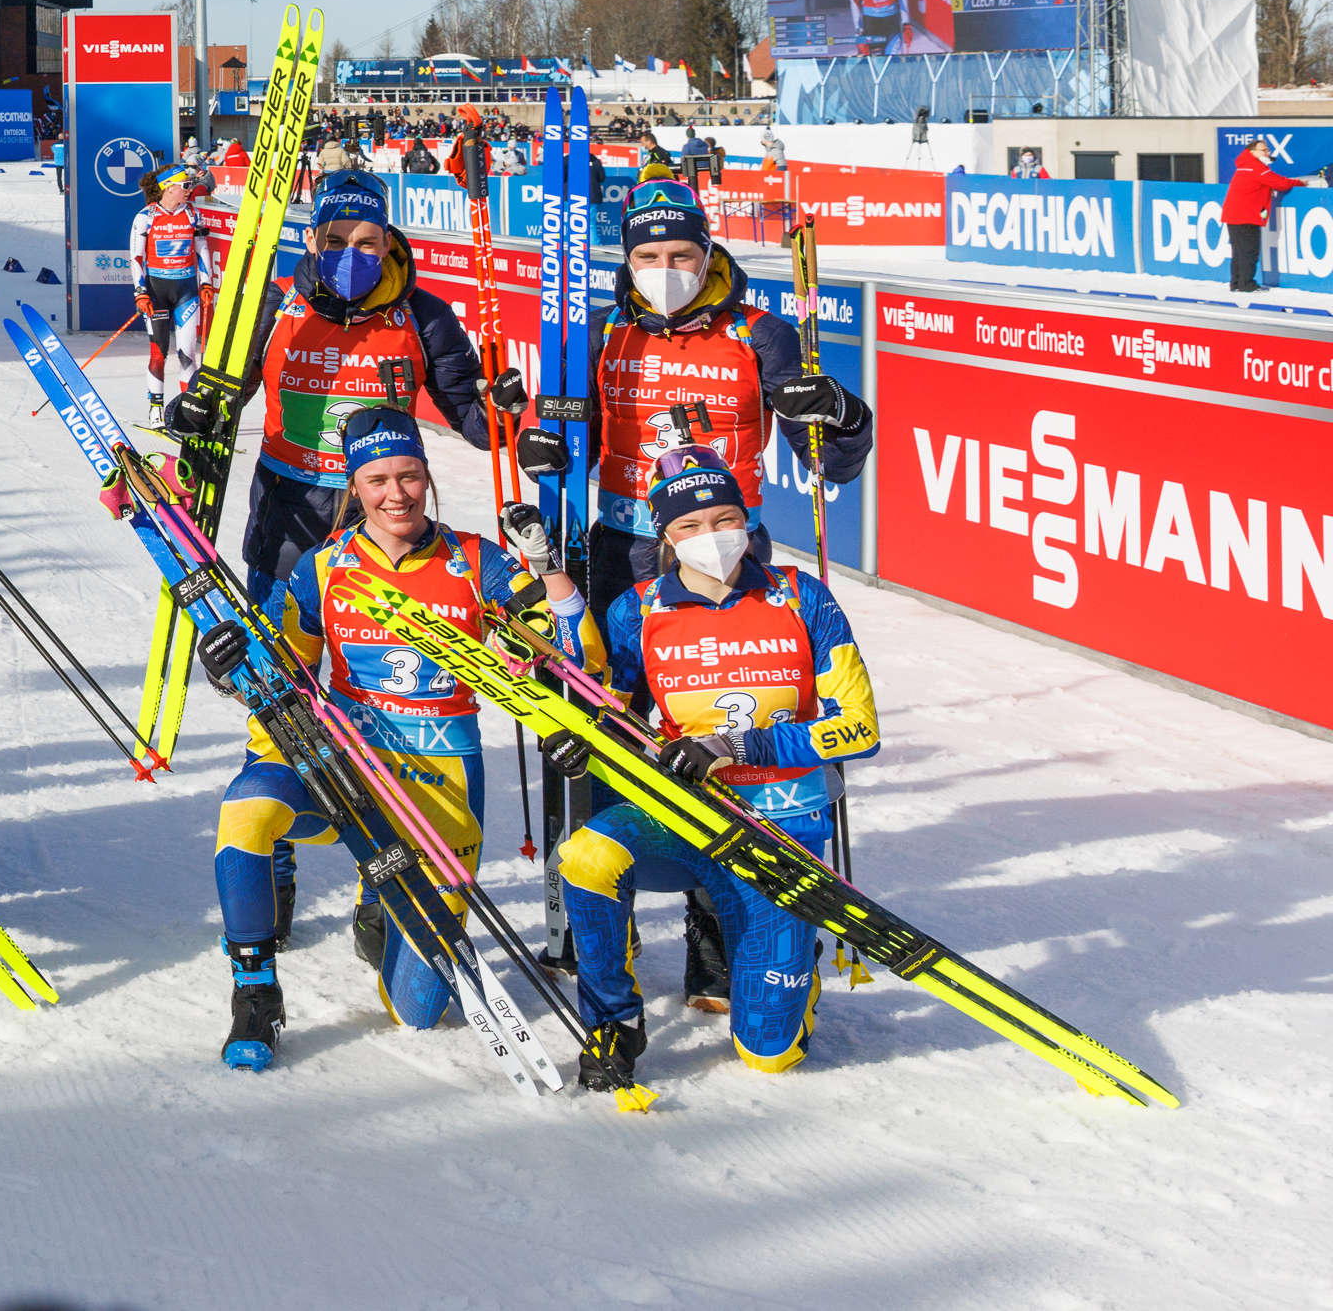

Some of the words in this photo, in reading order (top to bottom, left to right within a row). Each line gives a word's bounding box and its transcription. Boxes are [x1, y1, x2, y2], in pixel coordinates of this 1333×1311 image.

[83, 40, 165, 59] VIESSMANN
[248, 66, 288, 200] FISCHER
[272, 70, 311, 205] FISCHER
[1225, 134, 1254, 145] THE
[103, 140, 147, 158] BMW
[320, 192, 379, 209] FRISTADS
[800, 195, 942, 226] VIESSMANN
[629, 210, 685, 230] FRISTADS
[951, 191, 1115, 259] DECATHLON
[541, 193, 562, 326] SALOMON
[569, 194, 588, 326] SALOMON
[883, 301, 954, 341] VIESSMANN
[975, 316, 996, 345] for
[999, 324, 1025, 350] our
[1027, 321, 1085, 357] climate
[1111, 328, 1211, 375] VIESSMANN
[280, 371, 305, 385] for
[306, 376, 342, 391] our
[604, 354, 739, 383] VIESSMANN
[1243, 347, 1275, 385] for
[1277, 358, 1315, 389] our
[603, 382, 625, 398] for
[630, 386, 661, 400] our
[665, 387, 738, 407] climate
[348, 431, 411, 455] FRISTADS
[667, 473, 726, 497] FRISTADS
[913, 409, 1333, 621] VIESSMANN
[333, 623, 356, 639] for
[411, 608, 550, 704] FISCHER
[653, 636, 798, 667] VIESSMANN
[379, 648, 422, 695] 3
[395, 625, 534, 717] FISCHER
[657, 672, 683, 688] for
[687, 672, 723, 685] our
[727, 667, 802, 683] climate
[821, 720, 873, 750] SWE
[735, 769, 776, 784] estonia
[764, 969, 810, 989] SWE
